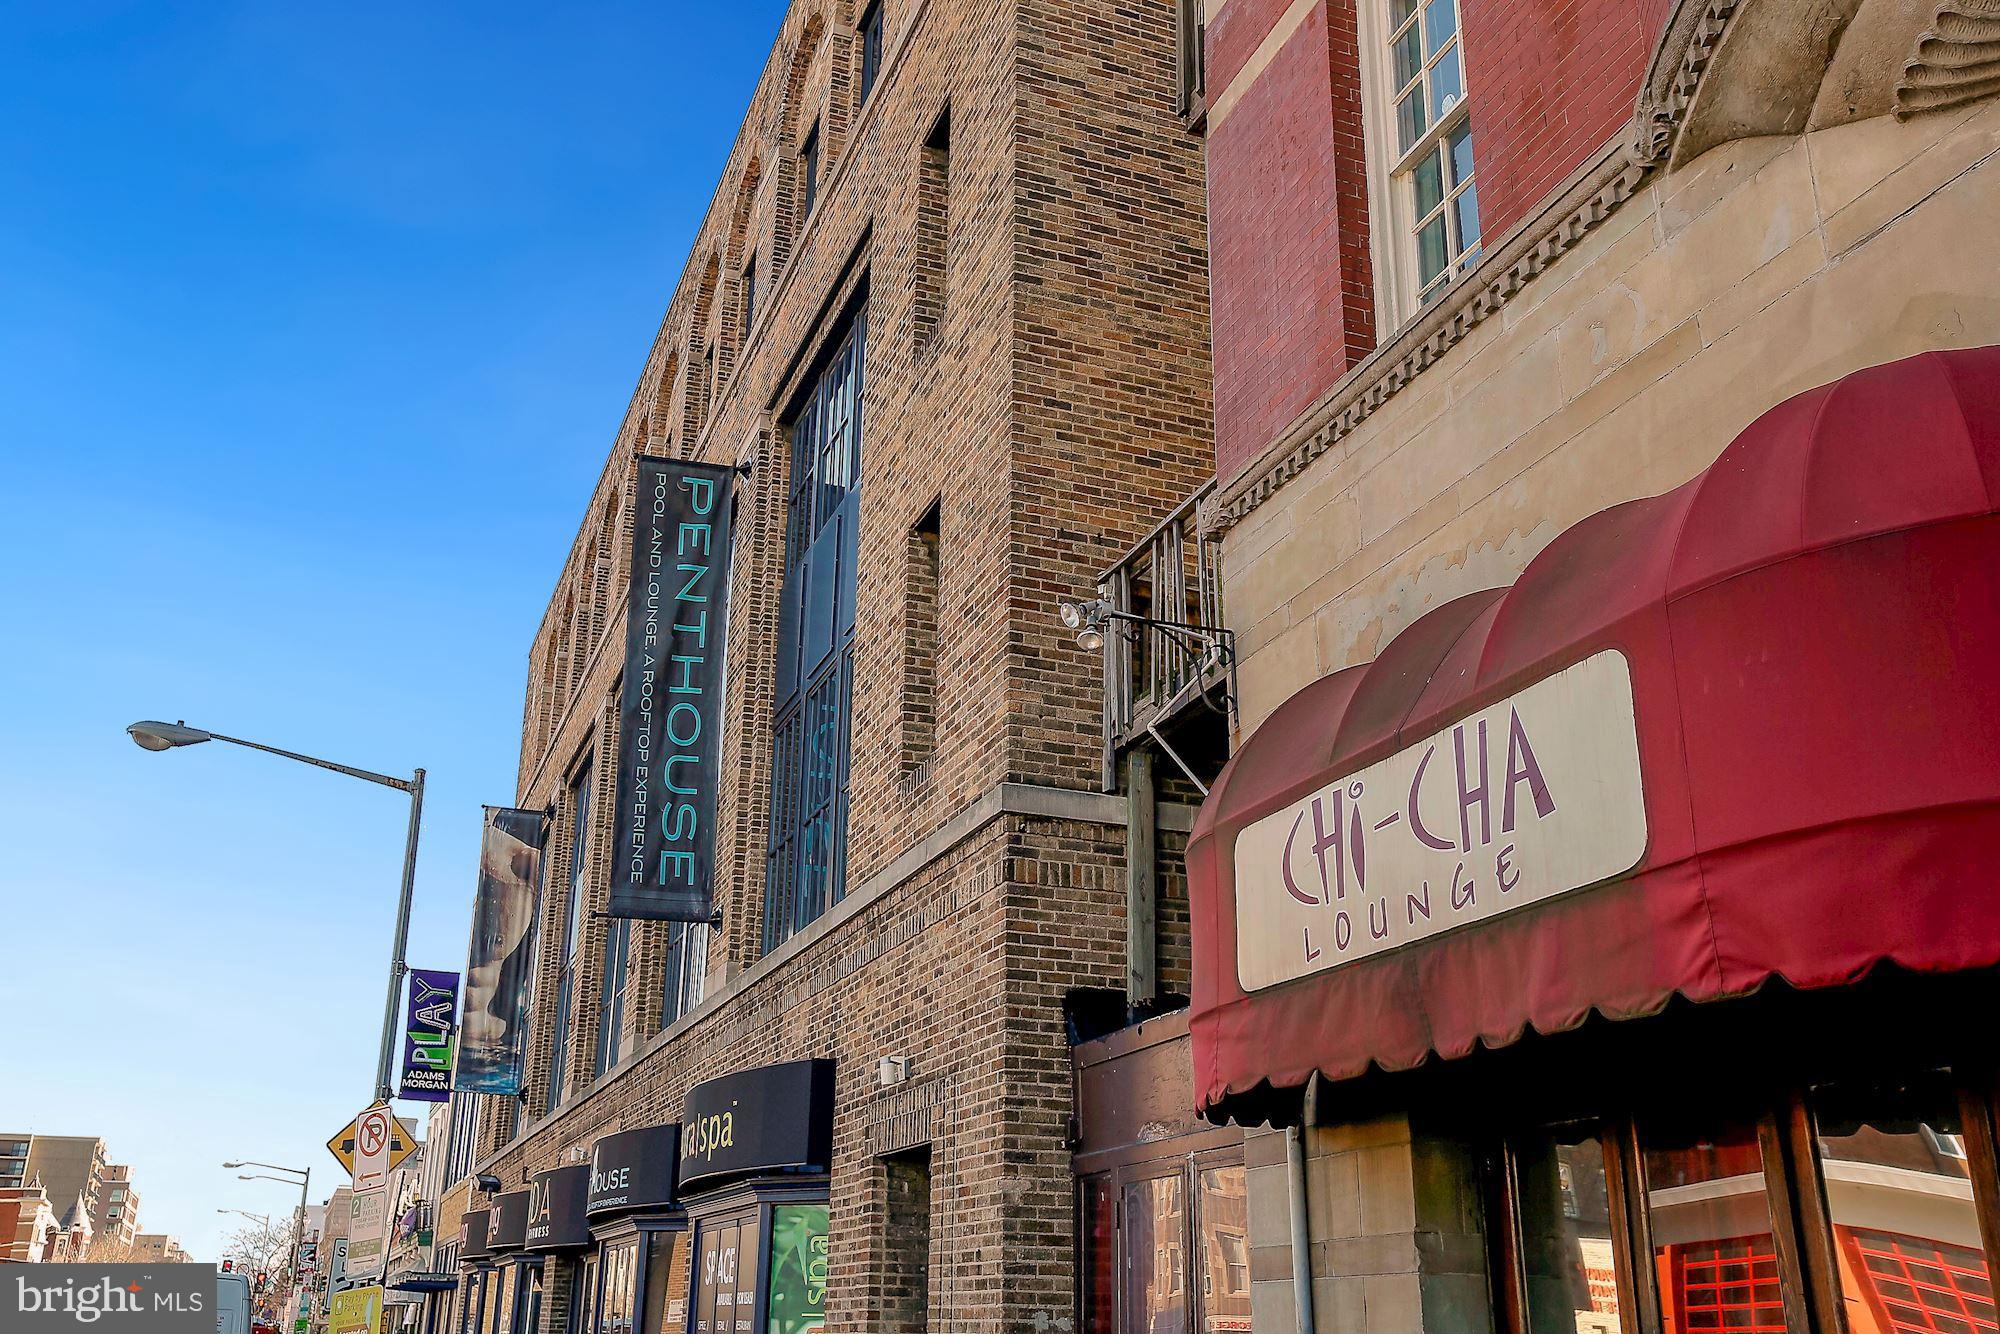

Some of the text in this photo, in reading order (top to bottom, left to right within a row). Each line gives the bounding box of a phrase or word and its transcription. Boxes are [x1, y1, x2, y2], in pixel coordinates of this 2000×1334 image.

[652, 472, 667, 525] POOL
[649, 527, 663, 568] AND
[643, 654, 656, 667] A
[659, 476, 714, 886] PENTHOUSE
[637, 670, 655, 761] ROOFTOP
[630, 766, 648, 884] EXPERIENCE
[1304, 844, 1521, 963] LOUNGE
[412, 977, 454, 1063] PLAY
[402, 1079, 449, 1090] MORGAN
[407, 1070, 445, 1081] ADAMS
[352, 1199, 360, 1215] 2
[705, 1247, 736, 1286] SPACE
